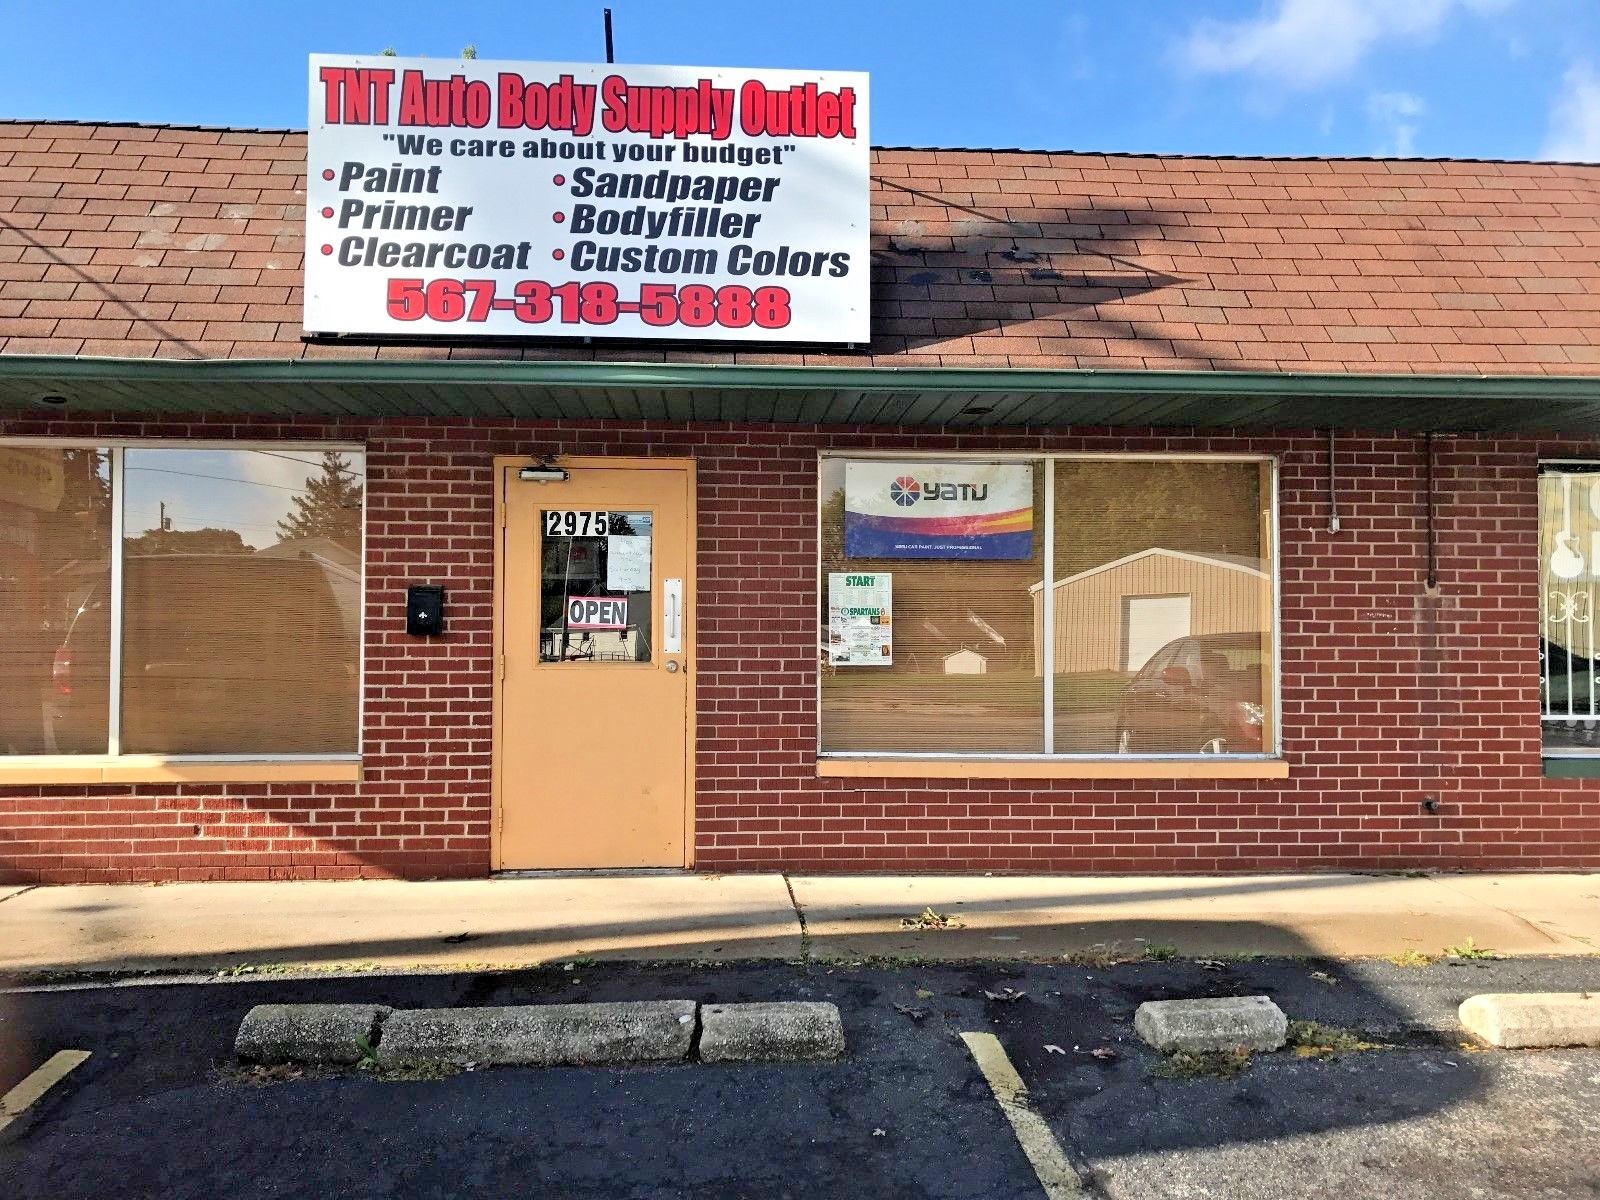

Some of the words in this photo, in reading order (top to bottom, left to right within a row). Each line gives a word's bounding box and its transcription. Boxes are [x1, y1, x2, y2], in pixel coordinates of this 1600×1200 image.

[320, 67, 395, 126] TNT
[399, 69, 491, 129] Auto
[497, 72, 597, 136] Body
[601, 75, 734, 140] Supply
[740, 79, 857, 139] Outlet
[382, 133, 443, 156] "We
[450, 137, 516, 157] care
[523, 138, 606, 160] about
[612, 142, 677, 163] your
[682, 142, 797, 167] budget"
[338, 162, 442, 194] Paint
[570, 167, 780, 204] Sandpaper
[338, 199, 472, 232] Primer
[570, 205, 761, 239] Bodyfiller
[338, 236, 532, 270] Clearcoat
[570, 241, 718, 275] Custom
[728, 244, 851, 278] Colors
[386, 278, 792, 329] 567-318-5888
[548, 511, 607, 536] 2975
[845, 575, 876, 587] START
[569, 599, 627, 625] OPEN
[849, 607, 881, 616] SPARTANS
